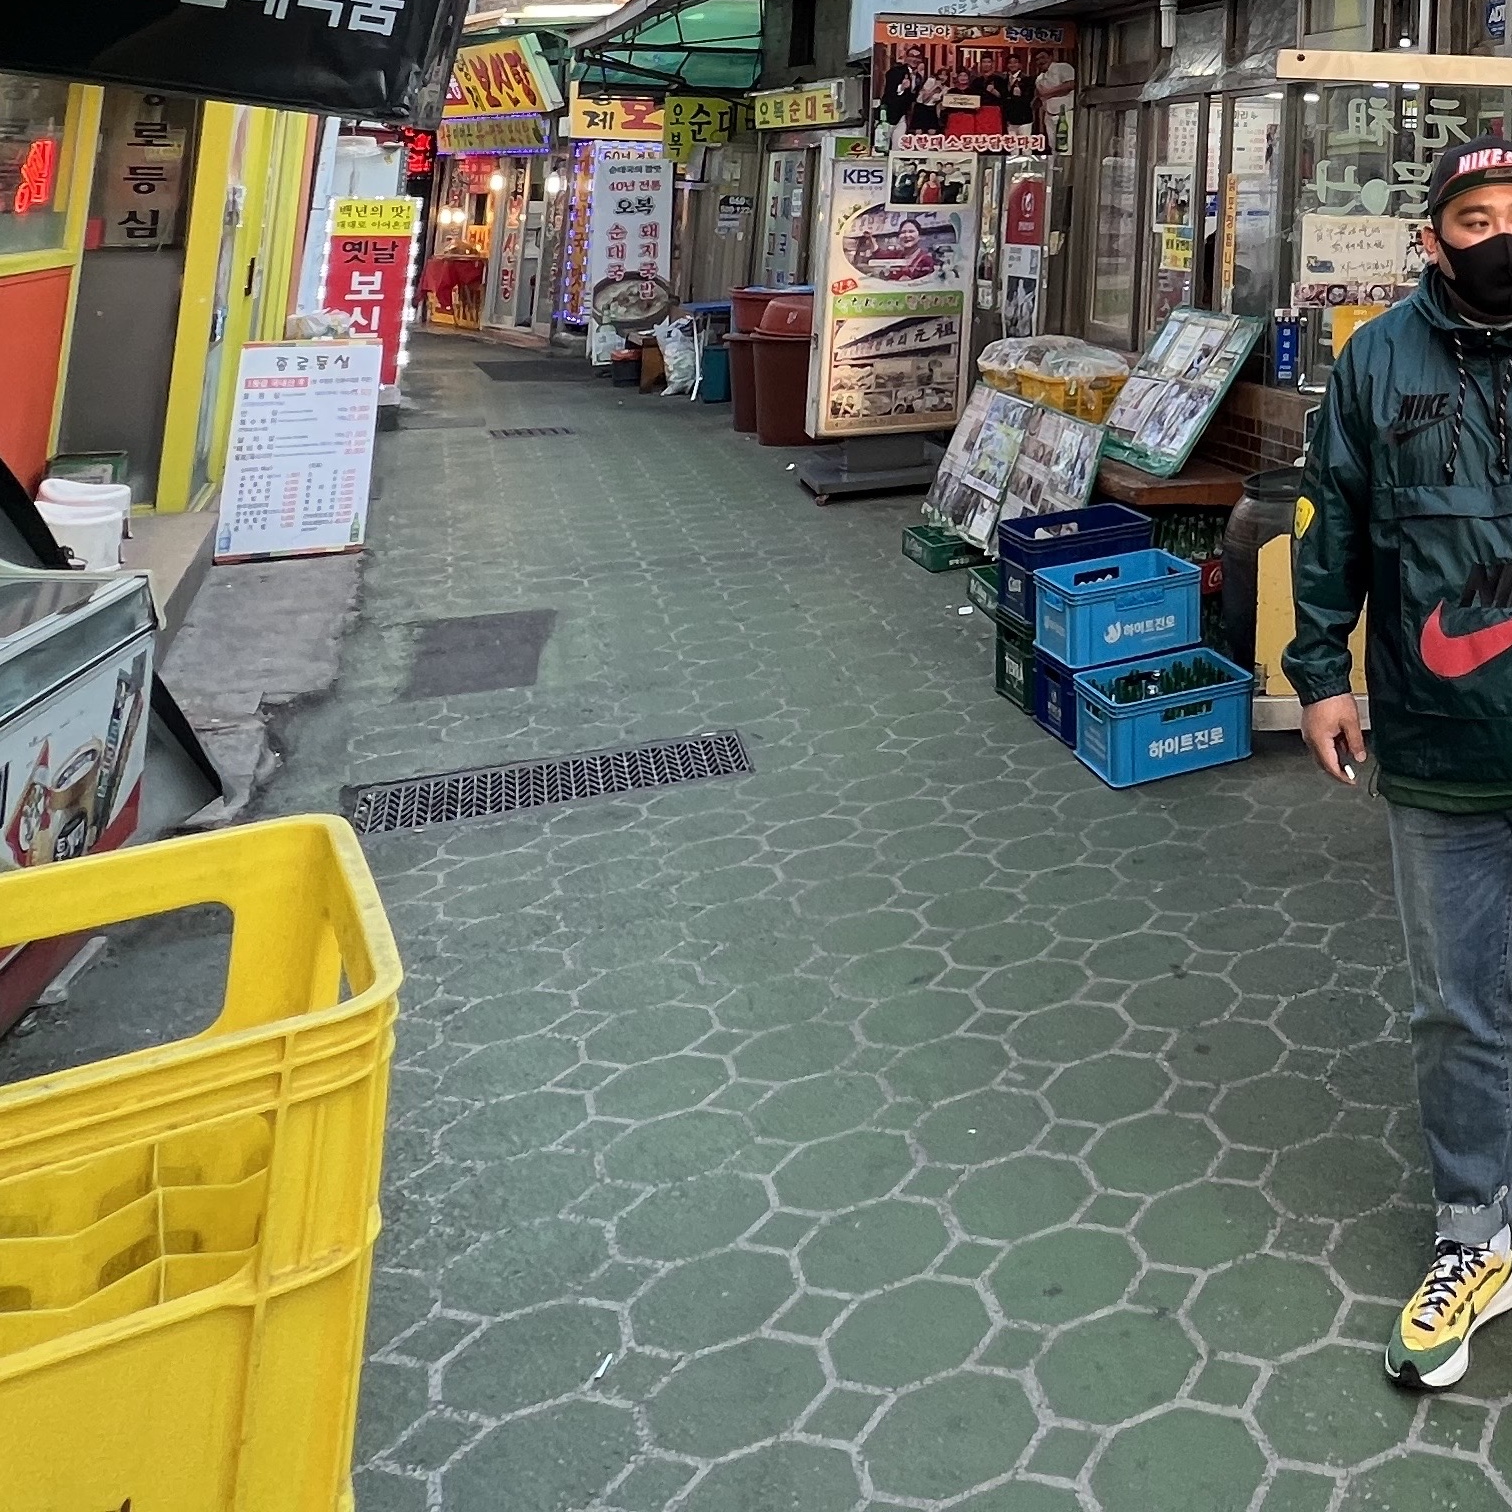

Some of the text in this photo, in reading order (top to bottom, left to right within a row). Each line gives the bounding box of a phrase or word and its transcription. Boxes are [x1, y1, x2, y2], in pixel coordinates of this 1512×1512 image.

[886, 22, 951, 39] 히말라야
[1458, 148, 1503, 175] NIKE
[608, 180, 662, 192] 40년 전통
[842, 168, 884, 185] KBS
[339, 204, 384, 219] 백년의
[614, 195, 655, 216] 오복
[341, 240, 400, 264] 옛날
[606, 222, 628, 281] 순대국
[638, 221, 660, 300] 돼지국밥
[1401, 392, 1450, 421] NIKE
[1123, 615, 1176, 636] 하이트진로
[1149, 726, 1225, 759] 하이트진로
